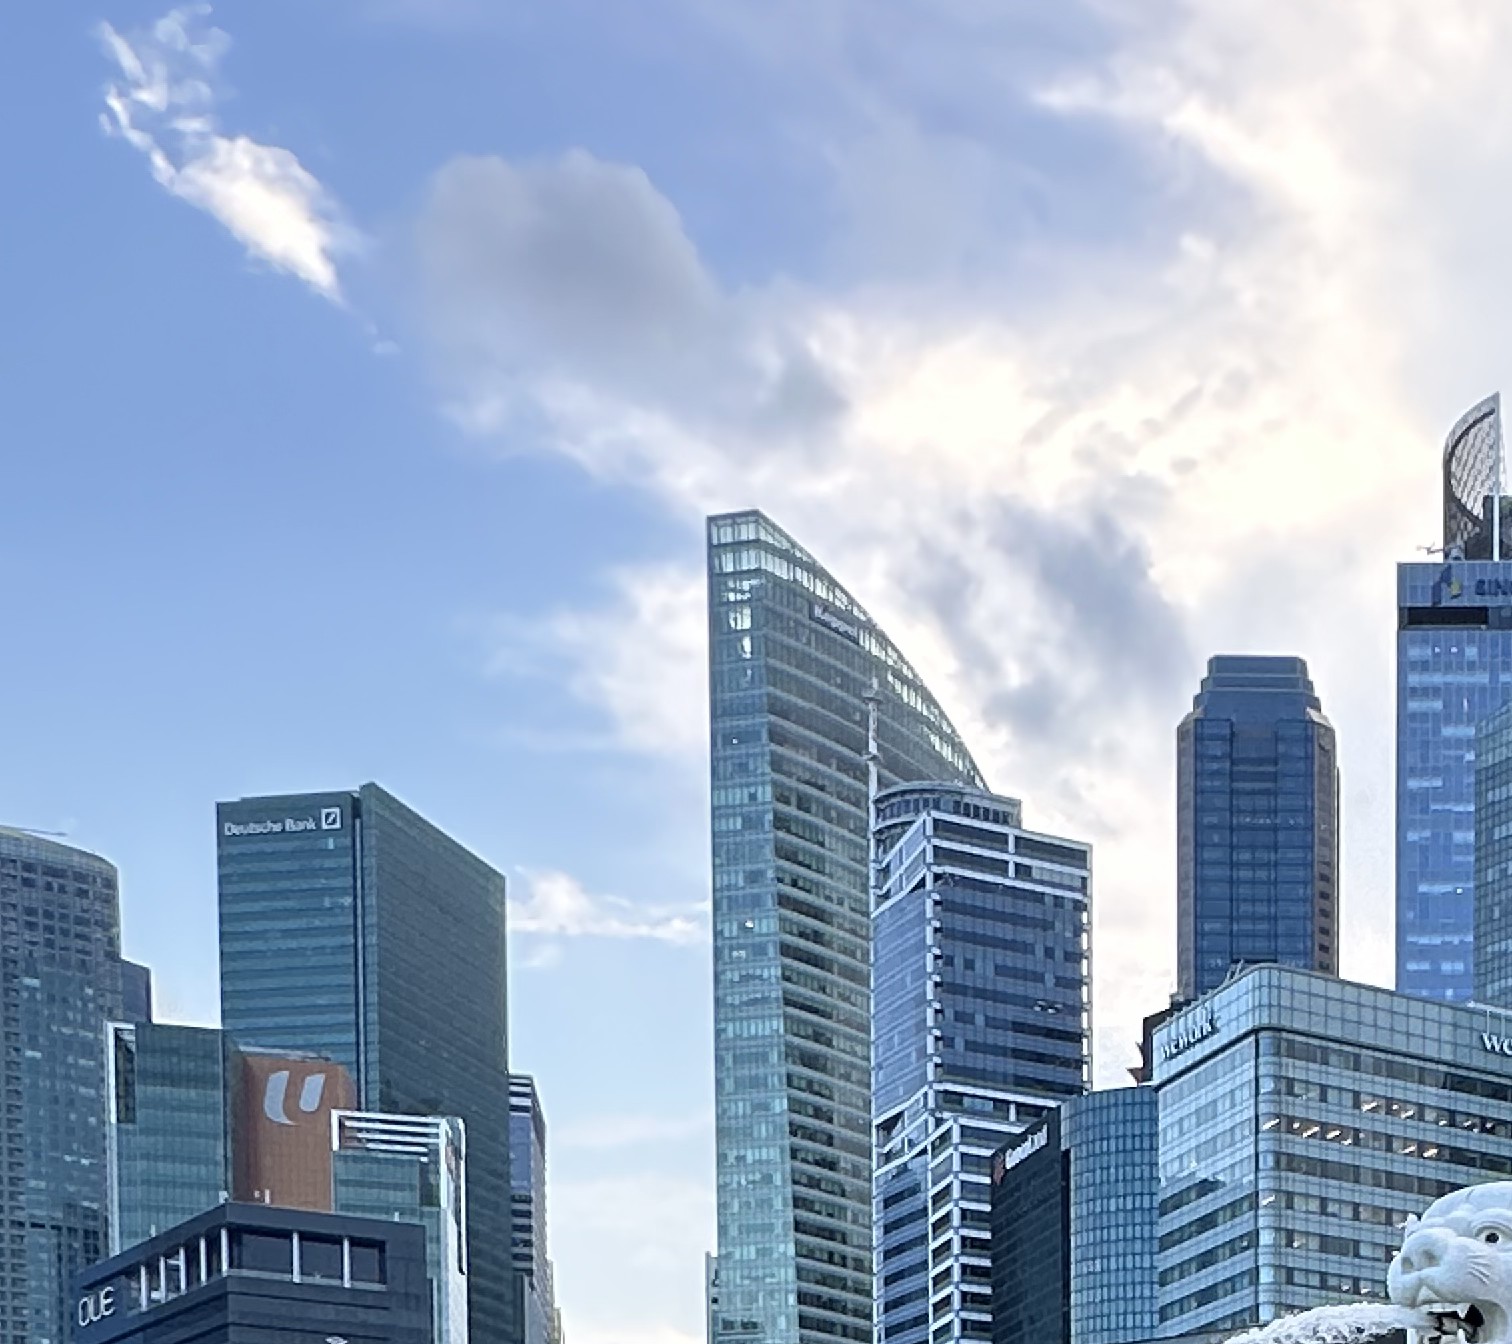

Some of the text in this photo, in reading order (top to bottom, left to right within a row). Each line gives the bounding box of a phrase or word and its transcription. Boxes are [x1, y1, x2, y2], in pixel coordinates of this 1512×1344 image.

[224, 817, 317, 836] Deutsche Bank
[79, 1286, 116, 1327] OUE
